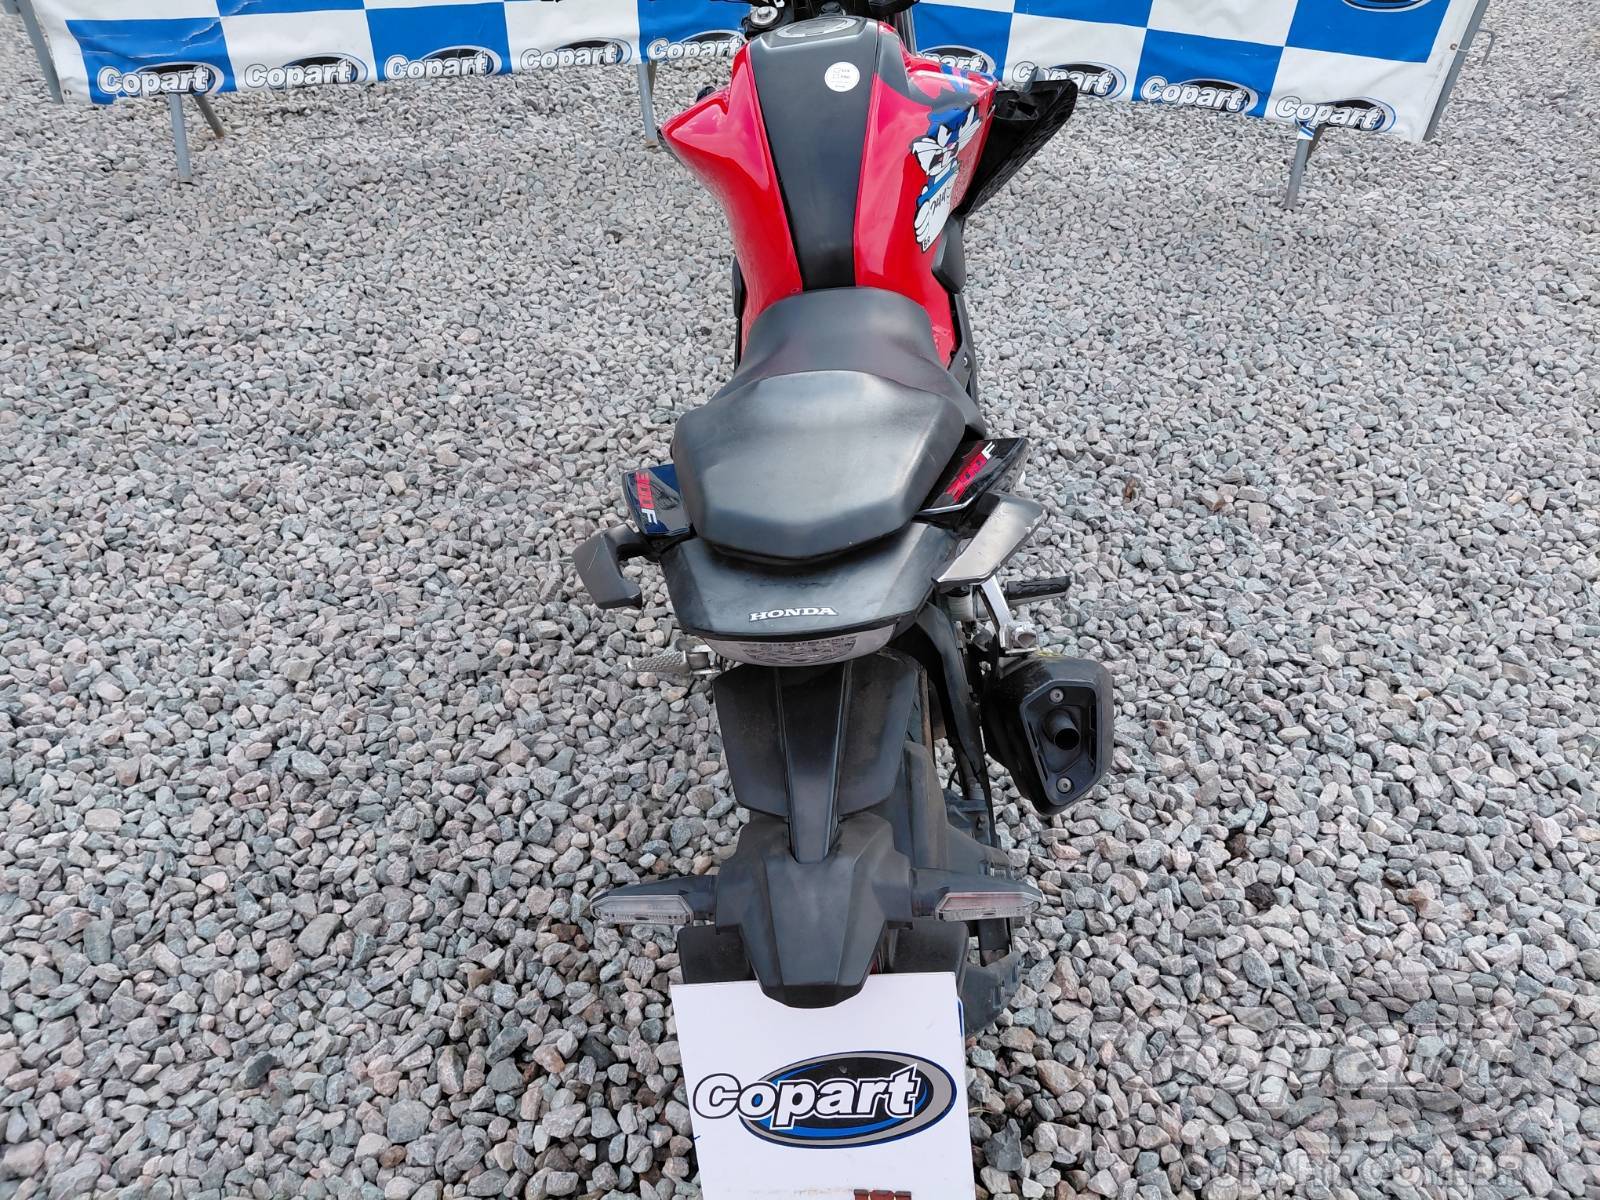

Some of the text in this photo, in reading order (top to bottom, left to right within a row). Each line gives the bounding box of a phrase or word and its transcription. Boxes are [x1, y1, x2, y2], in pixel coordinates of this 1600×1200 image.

[520, 43, 618, 70] Copart
[648, 35, 740, 59] Copart
[98, 62, 210, 96] Copart
[245, 58, 353, 89] Copart
[385, 51, 488, 78] Copart
[1011, 61, 1113, 95] Cpart
[1141, 76, 1246, 112] Copart
[1275, 96, 1382, 131] Copart
[749, 606, 838, 622] HONDA
[692, 1063, 922, 1130] Copart
